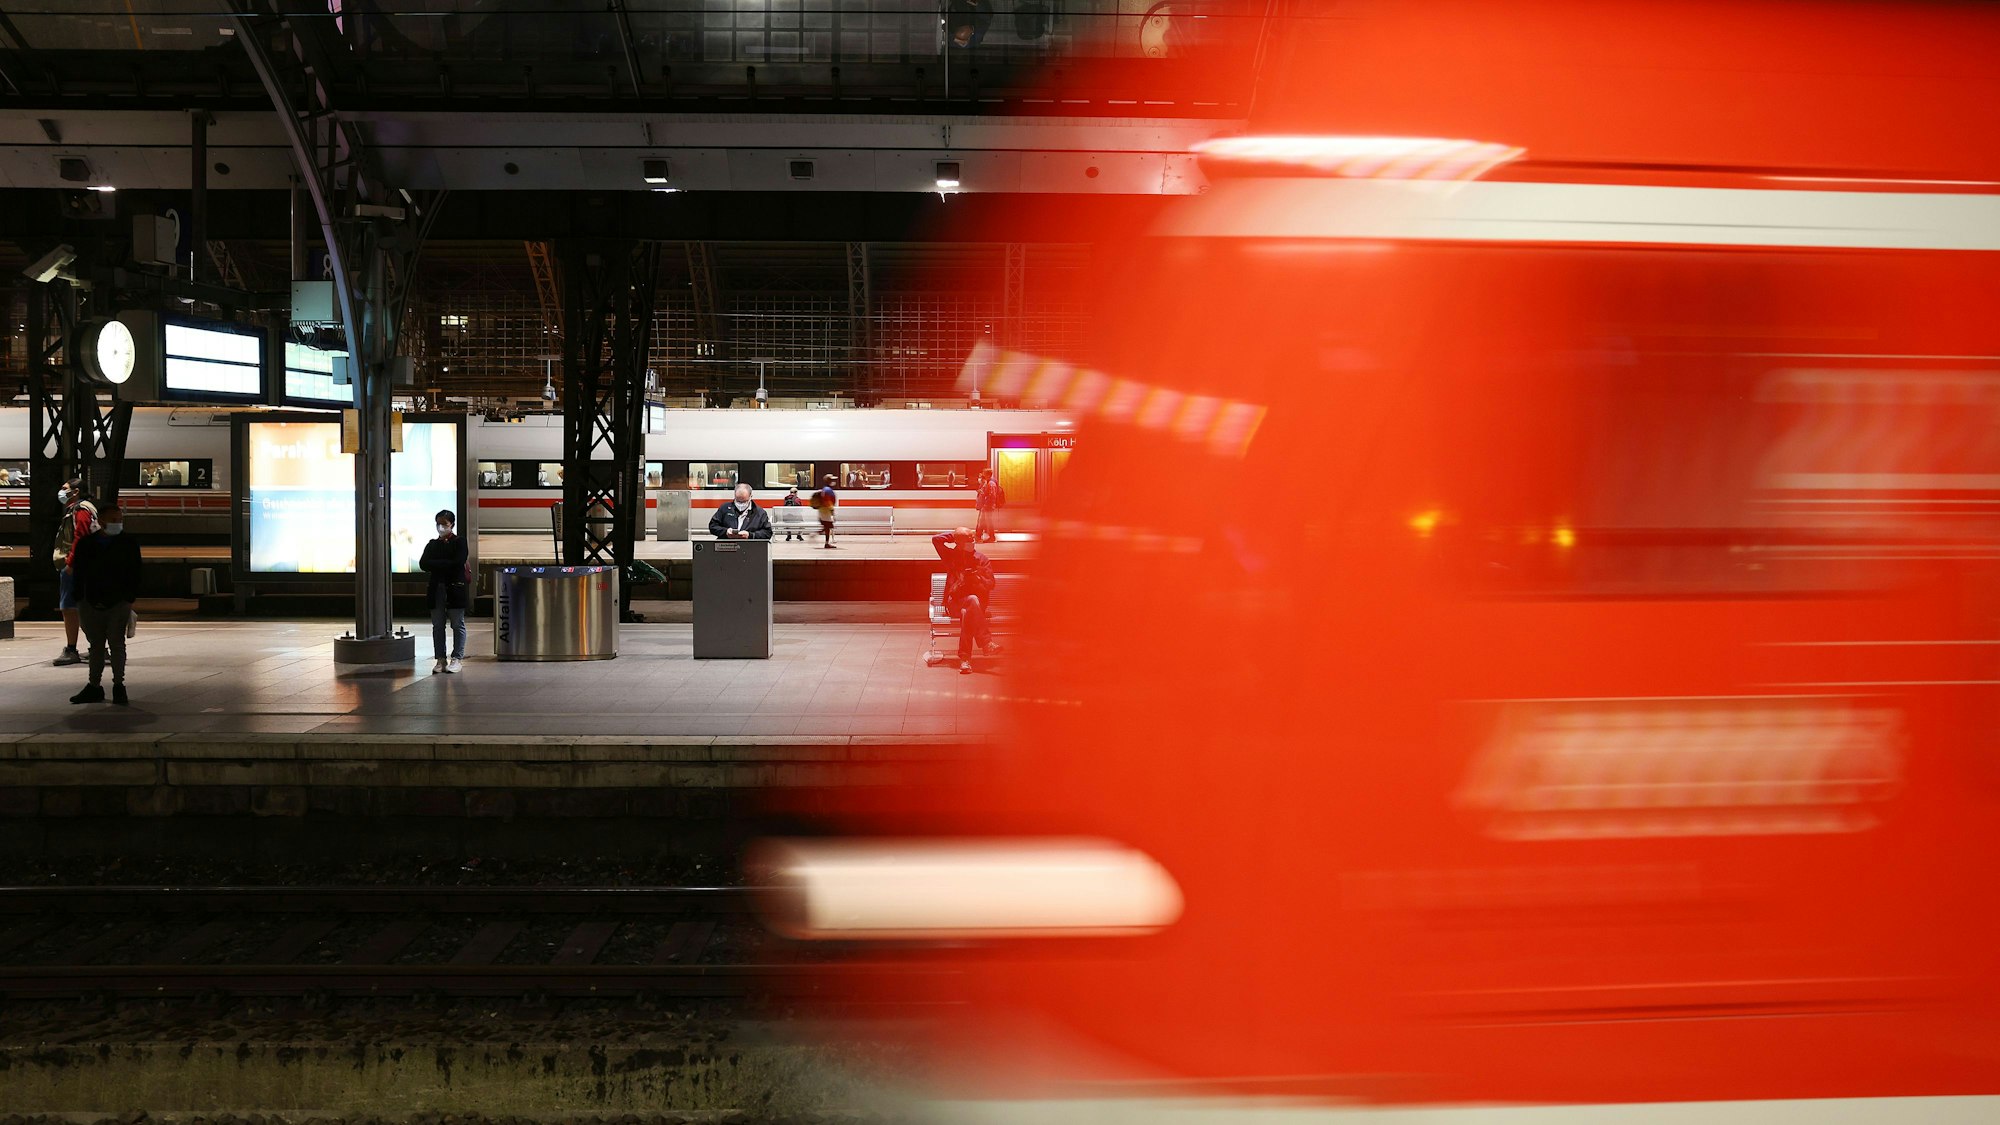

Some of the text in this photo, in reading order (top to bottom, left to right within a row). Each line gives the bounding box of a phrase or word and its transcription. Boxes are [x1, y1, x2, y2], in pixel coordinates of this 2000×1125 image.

[1047, 437, 1068, 447] Köln
[197, 467, 206, 480] 2
[499, 595, 510, 643] Abfall
